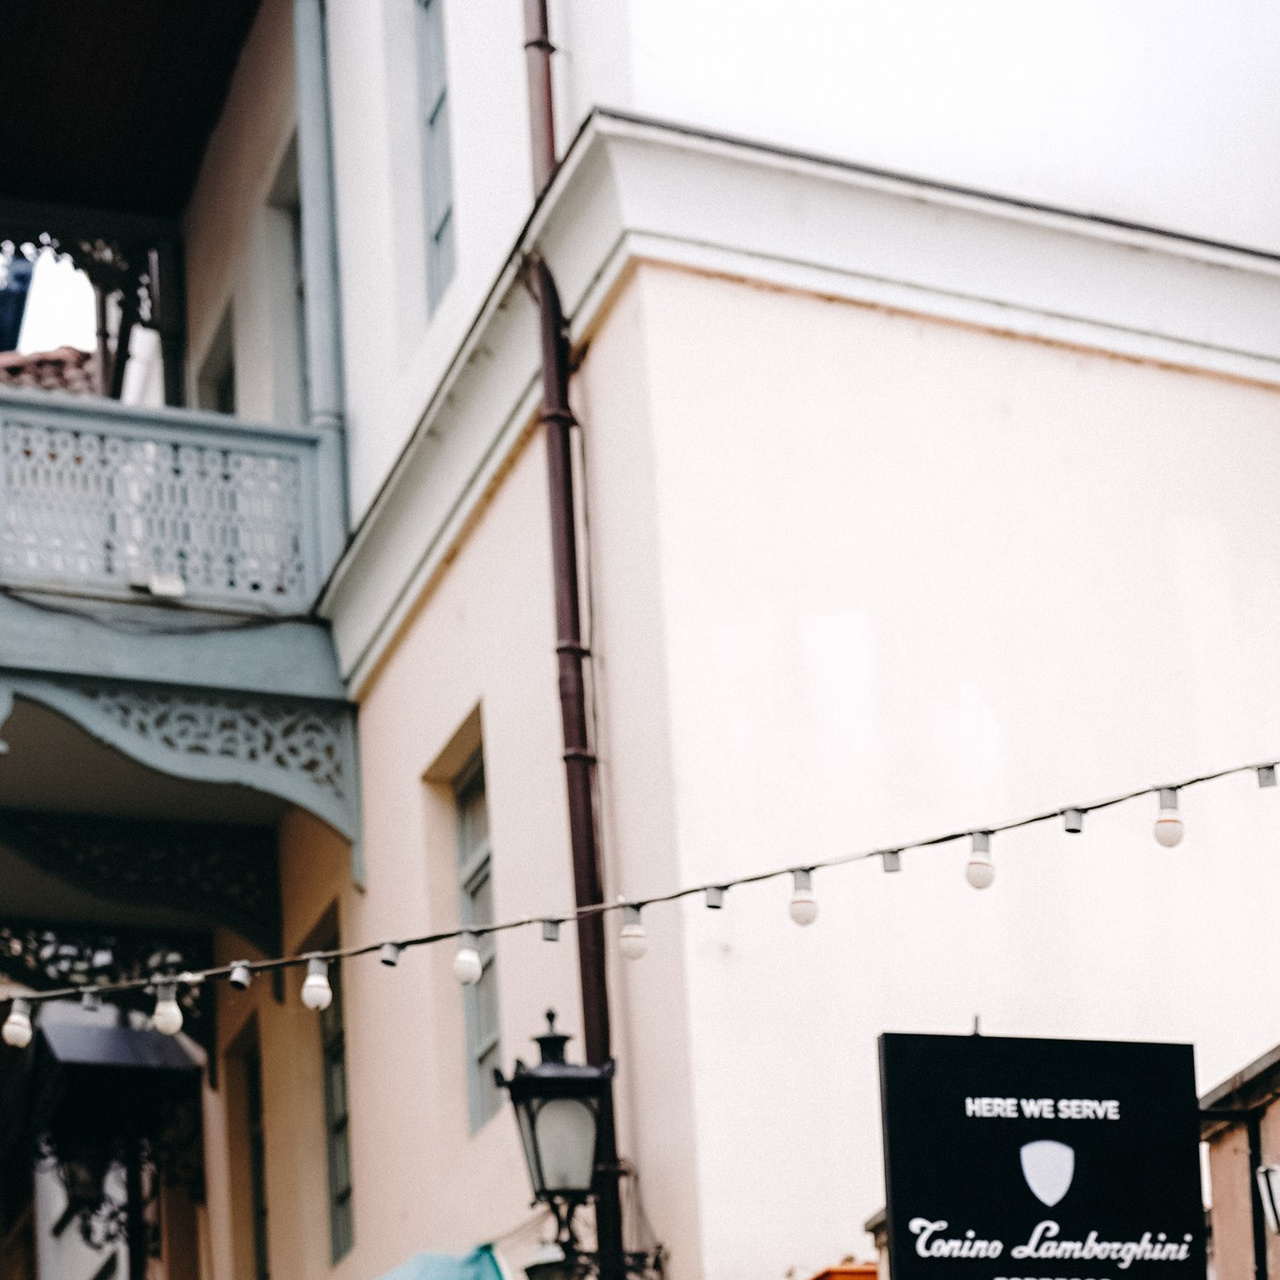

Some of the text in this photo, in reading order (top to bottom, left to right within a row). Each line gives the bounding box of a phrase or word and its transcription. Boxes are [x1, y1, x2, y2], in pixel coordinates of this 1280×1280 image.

[965, 1097, 1120, 1120] HERE WE SERVE
[909, 1218, 1192, 1269] Tonino Lamborghini
